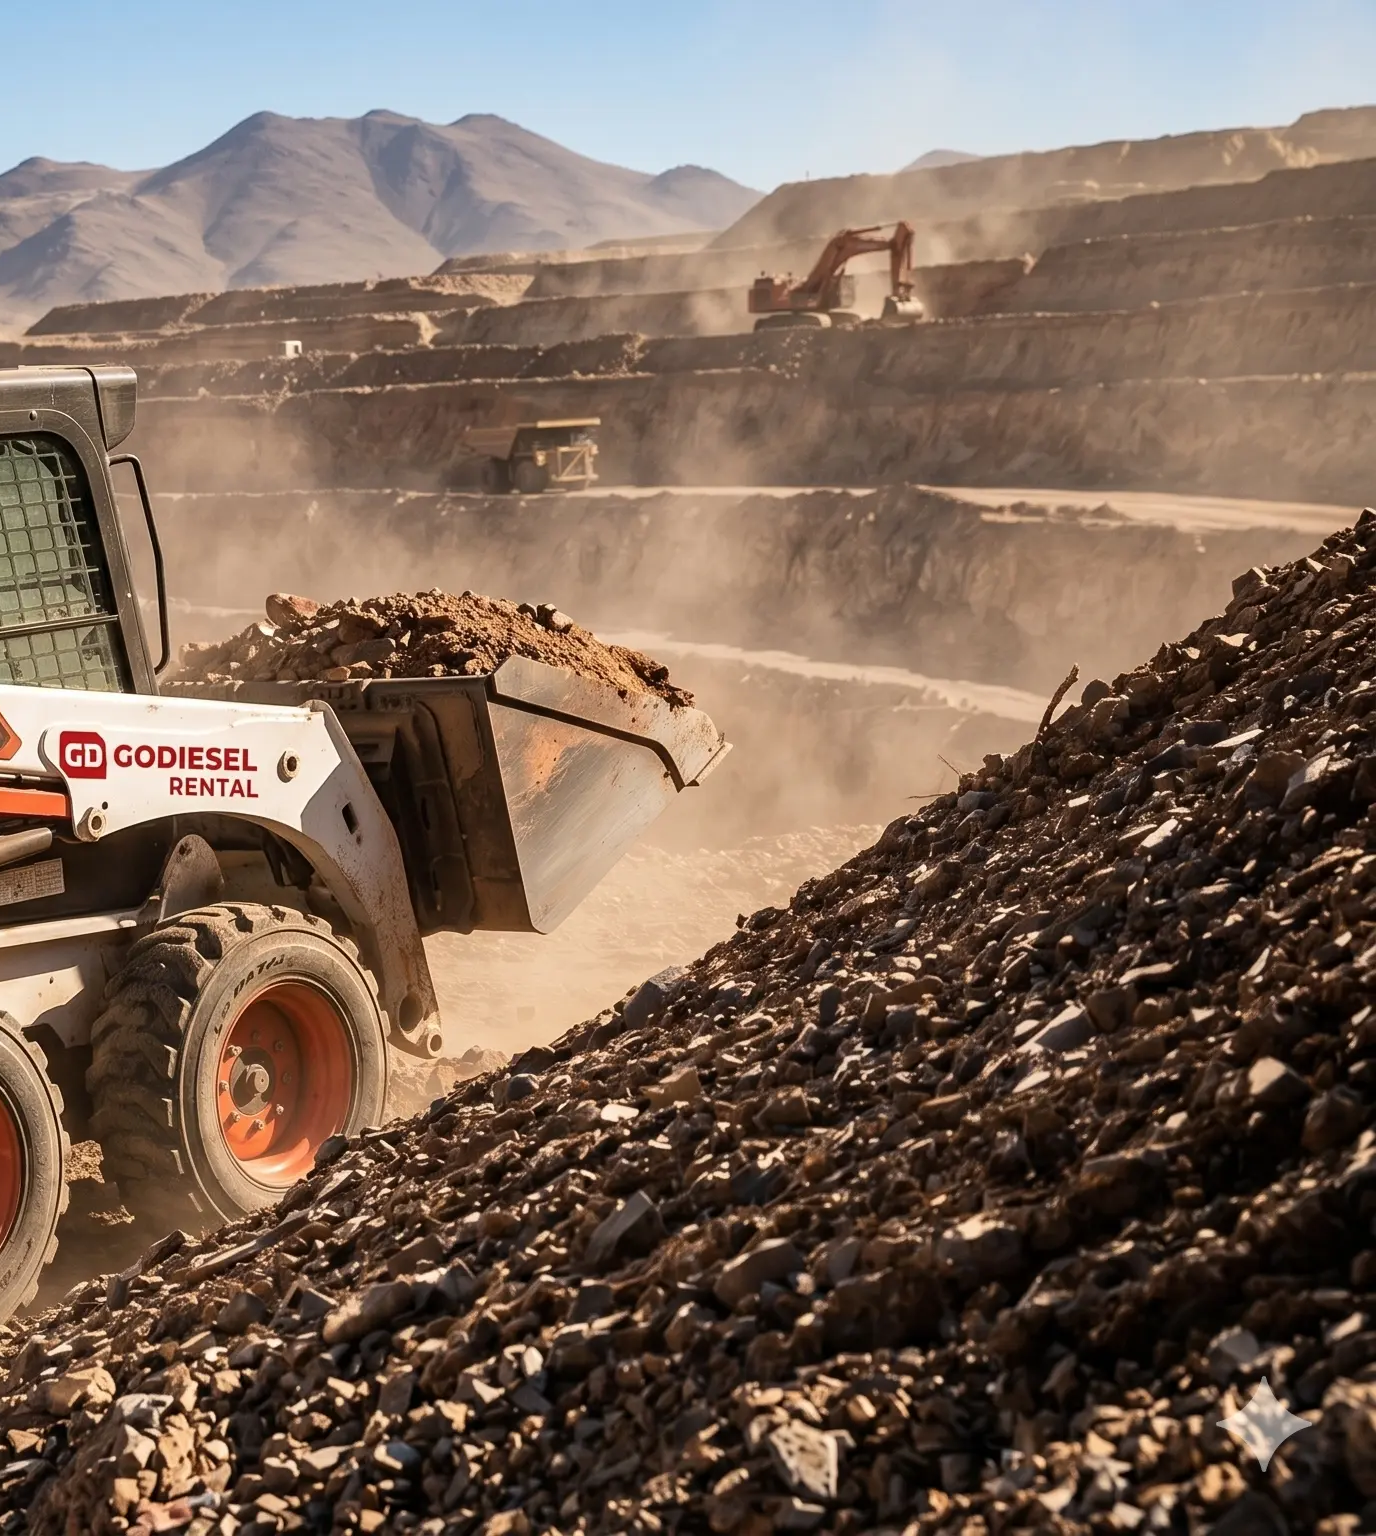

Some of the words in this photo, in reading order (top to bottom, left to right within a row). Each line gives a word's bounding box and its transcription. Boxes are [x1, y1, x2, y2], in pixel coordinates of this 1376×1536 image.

[64, 742, 103, 768] GD
[113, 744, 258, 772] GODIESEL
[169, 776, 259, 798] RENTAL
